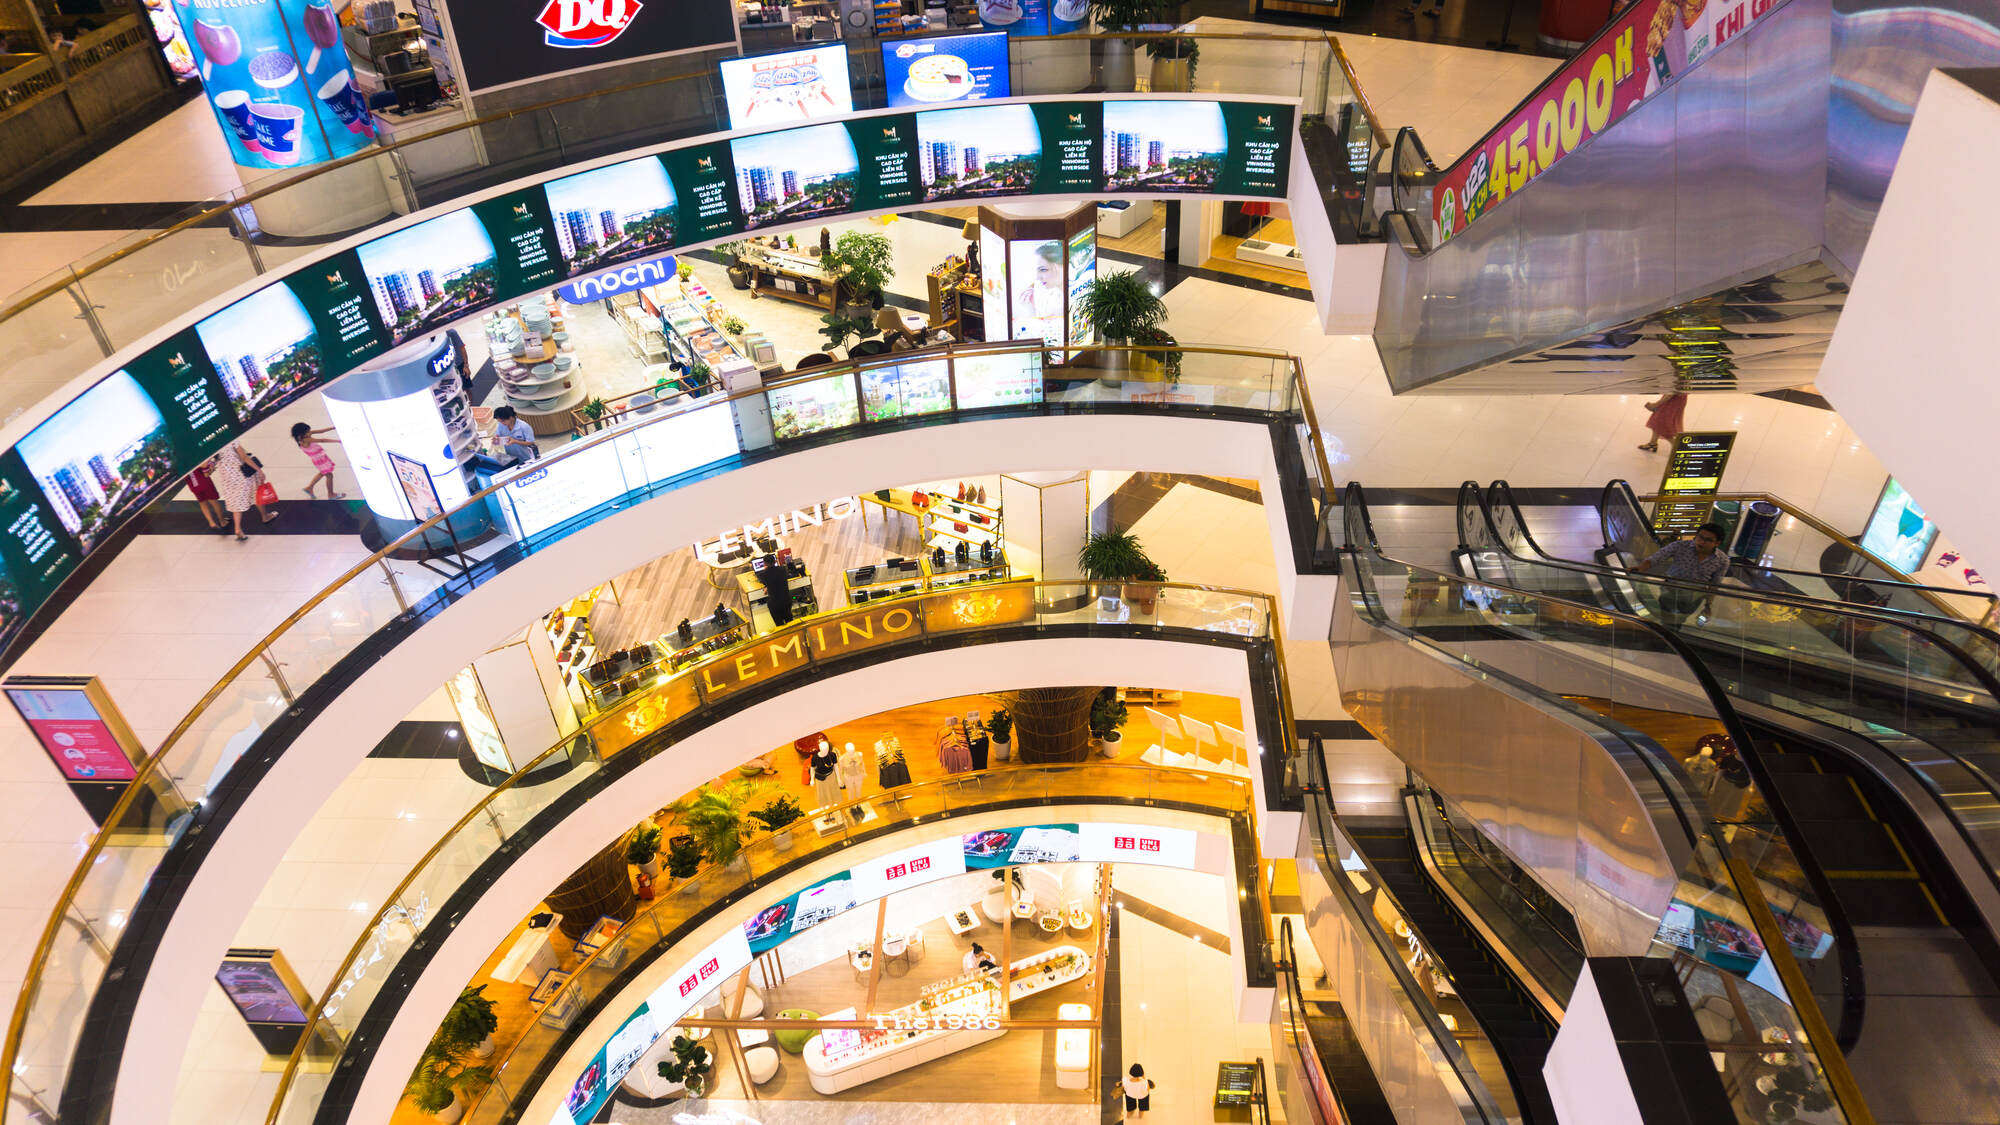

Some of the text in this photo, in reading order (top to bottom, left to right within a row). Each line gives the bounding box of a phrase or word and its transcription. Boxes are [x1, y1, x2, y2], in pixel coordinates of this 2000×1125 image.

[1716, 3, 1745, 47] KHI
[1462, 151, 1487, 211] U22
[699, 201, 727, 211] VINHOMES
[700, 207, 728, 217] RIVERSIDE
[518, 249, 546, 261] VINHOMES
[520, 255, 548, 268] RIVERSIDE
[693, 495, 856, 562] LEMINO
[702, 608, 913, 694] LEMINO
[911, 858, 927, 867] UNI
